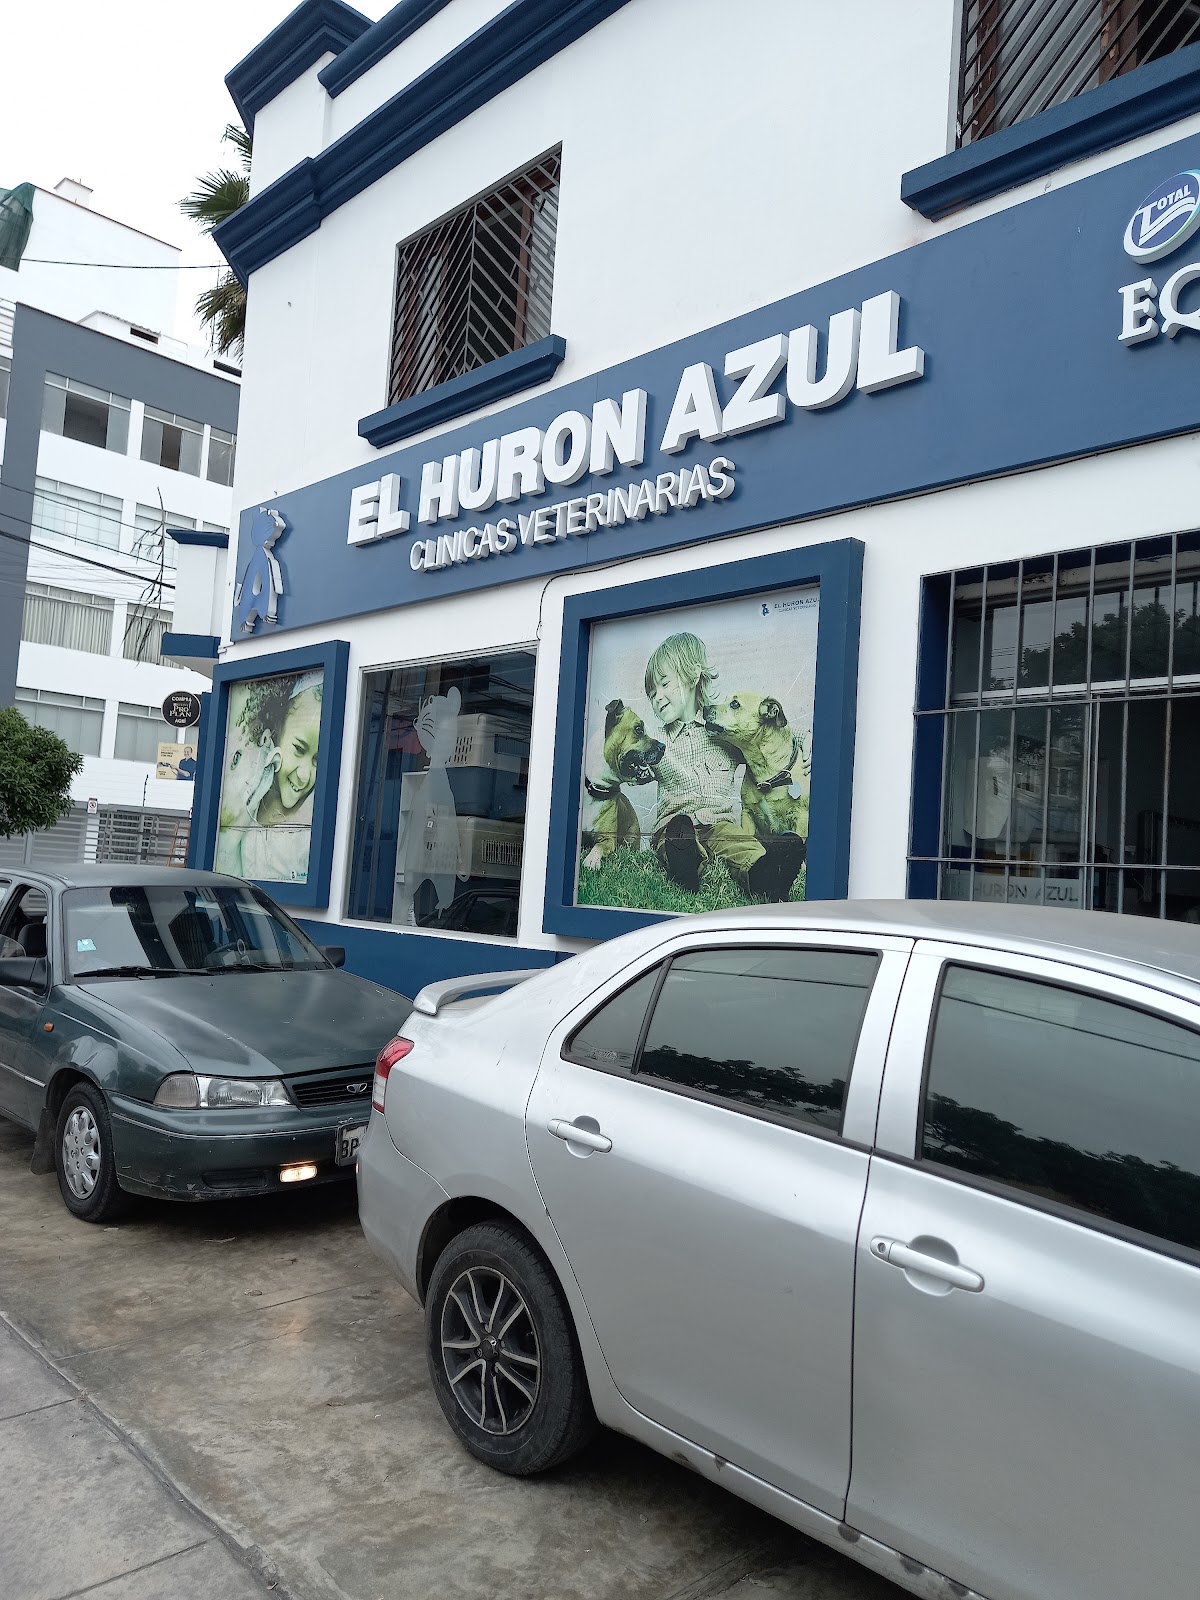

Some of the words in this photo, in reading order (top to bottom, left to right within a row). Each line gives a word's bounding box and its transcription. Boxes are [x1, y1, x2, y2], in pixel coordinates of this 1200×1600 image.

[1137, 184, 1192, 246] TOTAL
[346, 472, 411, 547] EL
[417, 388, 648, 525] HURON
[660, 289, 925, 454] AZUL
[408, 517, 518, 573] CLINICAS
[517, 456, 736, 547] VETERINARIAS
[169, 709, 192, 718] PLAN
[173, 704, 189, 713] PRO
